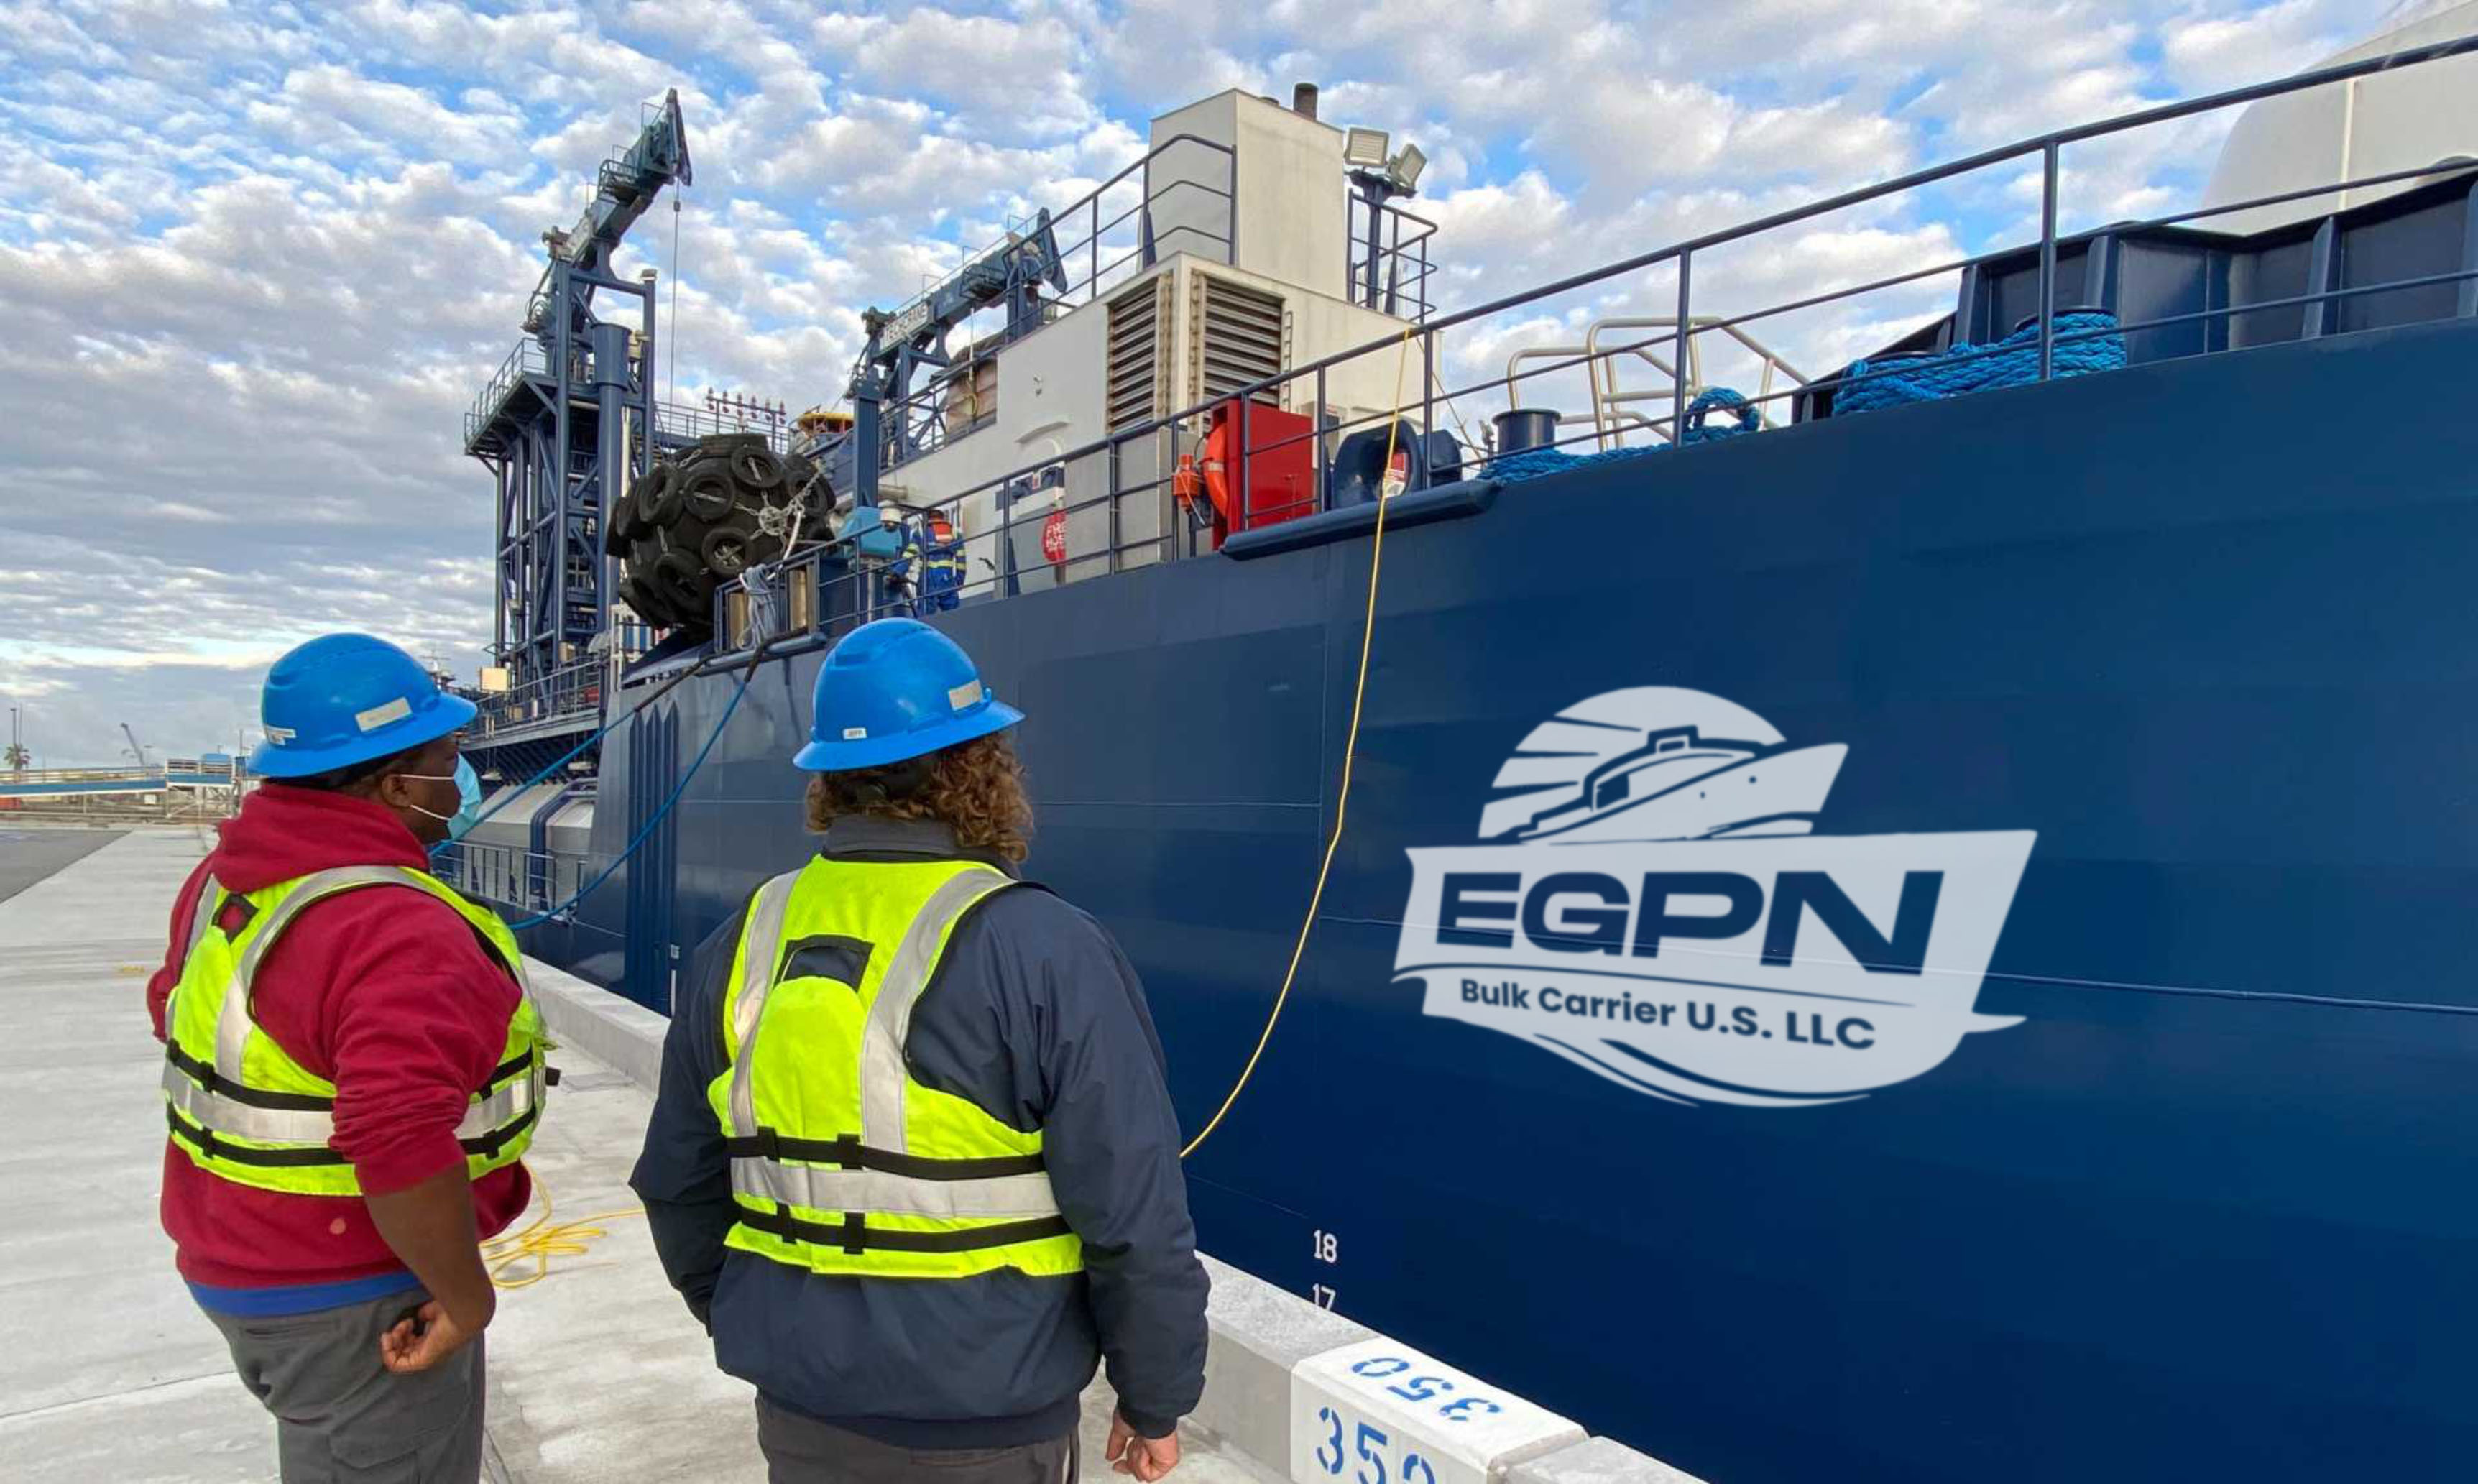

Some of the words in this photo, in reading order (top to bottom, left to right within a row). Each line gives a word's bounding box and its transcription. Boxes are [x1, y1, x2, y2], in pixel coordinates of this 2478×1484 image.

[1314, 1230, 1337, 1263] 18
[1312, 1283, 1336, 1311] 17
[1352, 1357, 1500, 1421] 350
